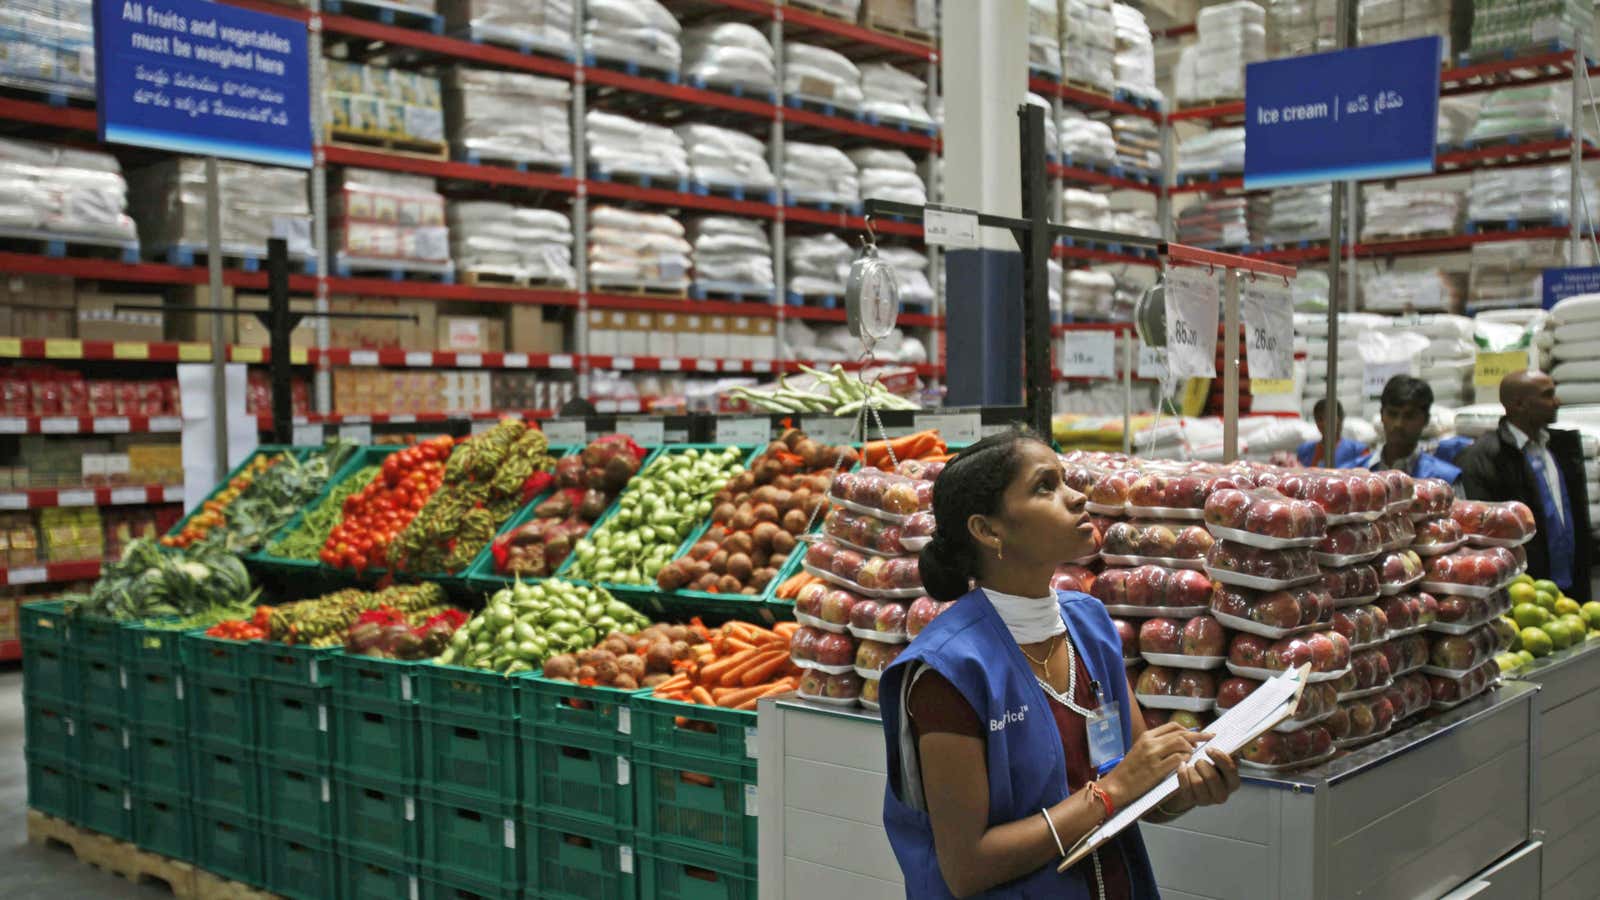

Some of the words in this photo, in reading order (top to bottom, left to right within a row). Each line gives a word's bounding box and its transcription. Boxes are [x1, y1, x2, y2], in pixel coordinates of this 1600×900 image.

[122, 1, 143, 23] All
[146, 6, 187, 32] fruits
[190, 19, 217, 38] and
[219, 26, 291, 54] vegetables
[132, 33, 169, 53] must
[173, 36, 192, 58] be
[194, 45, 254, 70] weighed
[255, 52, 285, 76] here
[1257, 107, 1279, 124] Ice
[1282, 103, 1328, 122] cream
